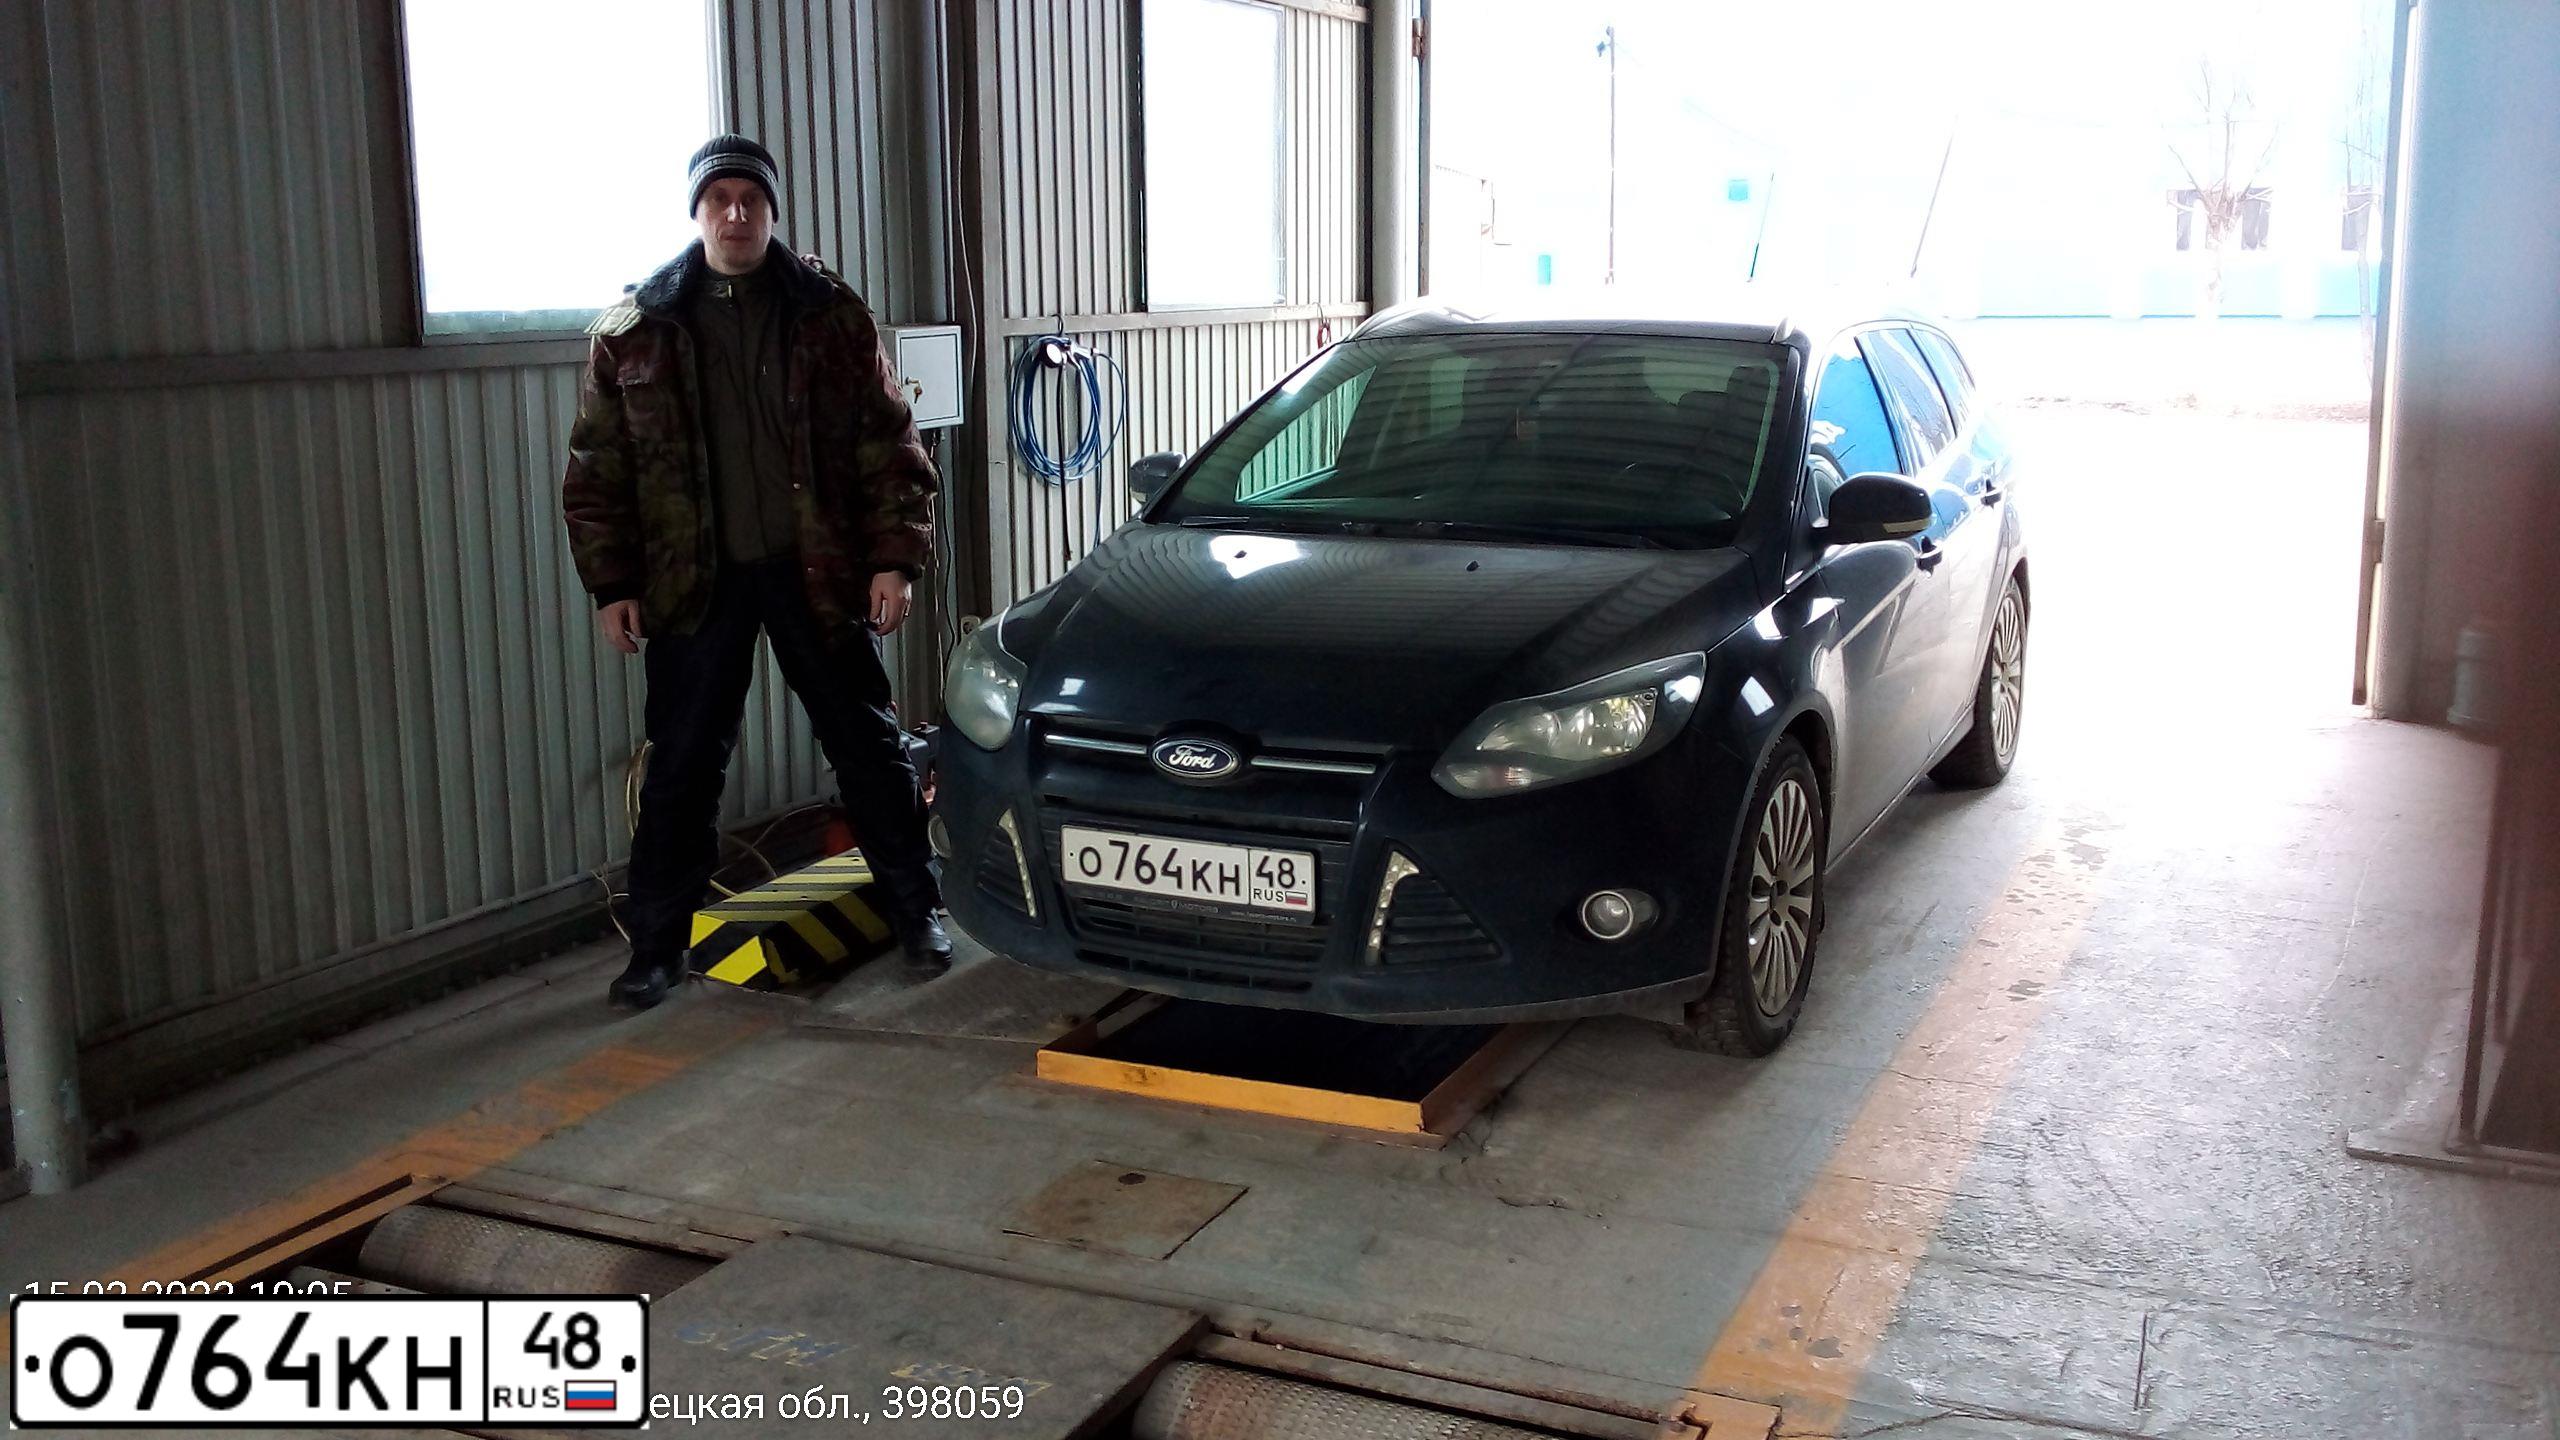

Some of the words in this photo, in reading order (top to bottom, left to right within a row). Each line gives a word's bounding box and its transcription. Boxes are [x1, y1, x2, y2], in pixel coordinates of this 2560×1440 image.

[1168, 744, 1216, 770] Ford
[1255, 855, 1296, 888] 48
[1252, 887, 1285, 902] RUS
